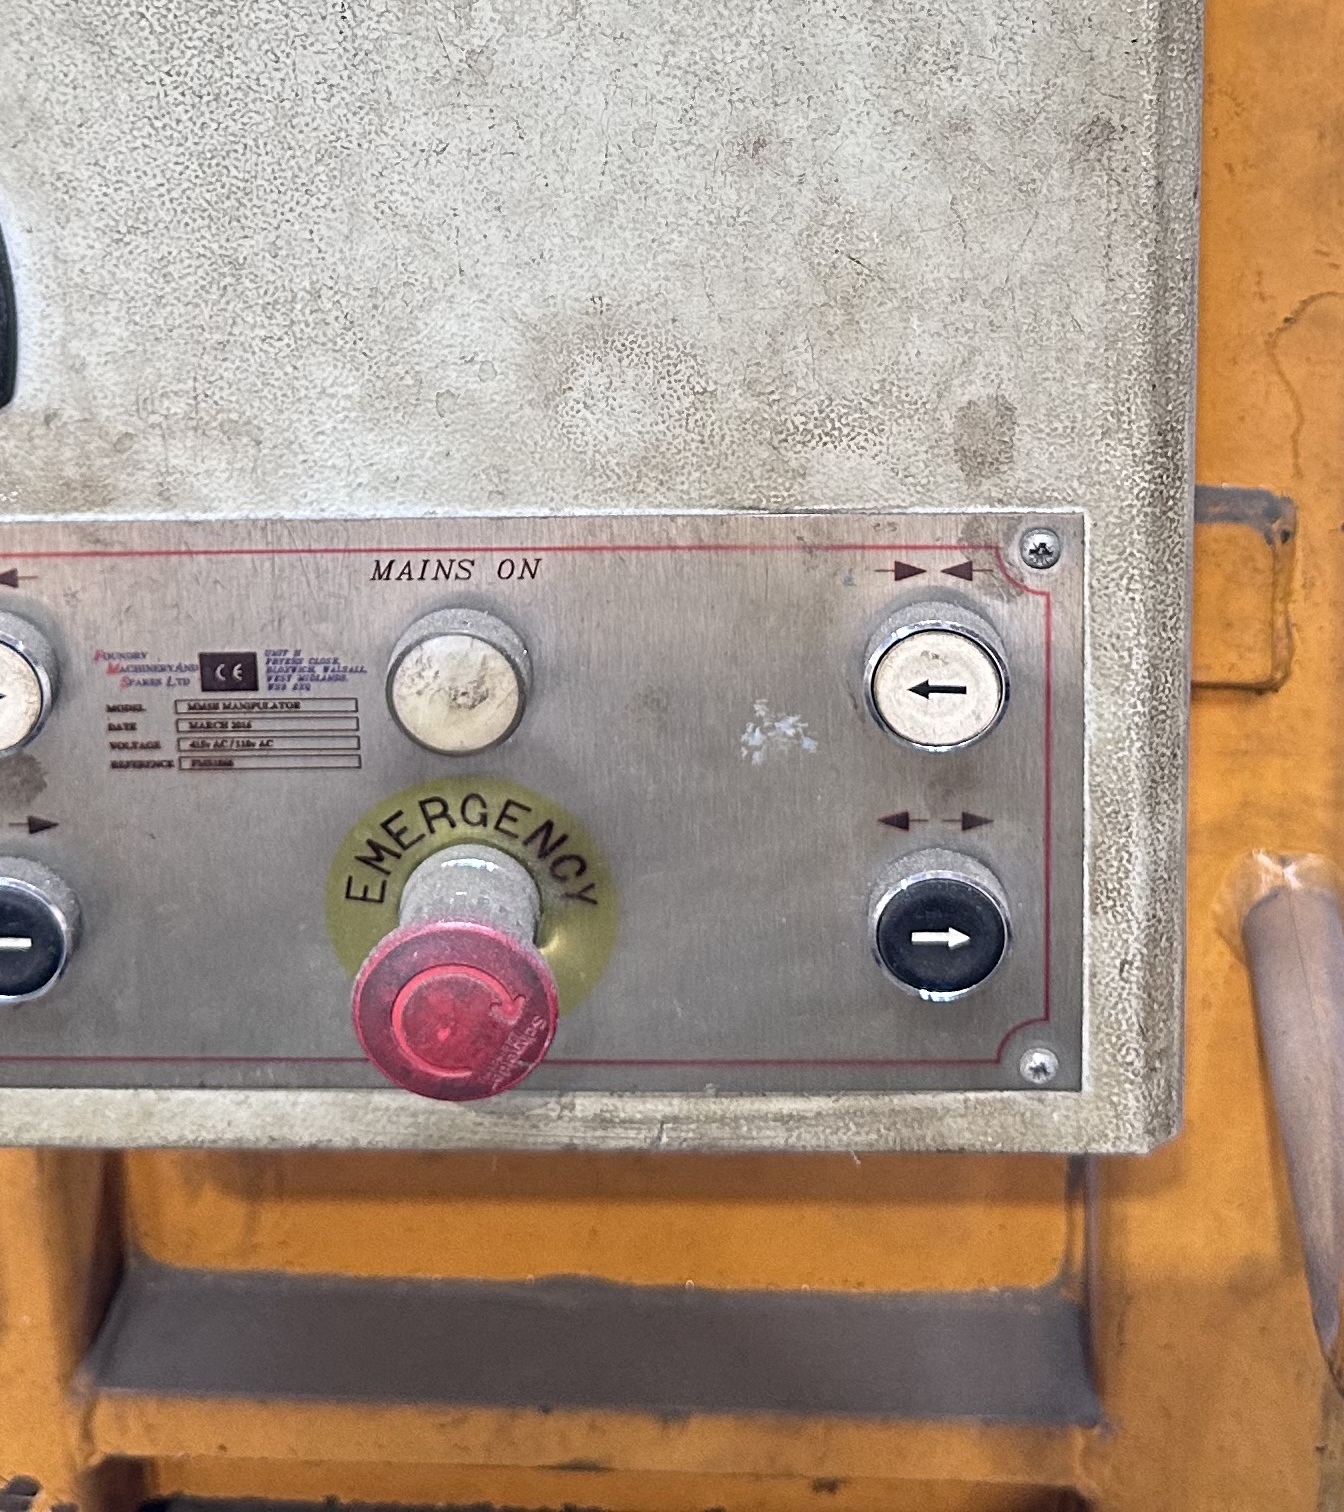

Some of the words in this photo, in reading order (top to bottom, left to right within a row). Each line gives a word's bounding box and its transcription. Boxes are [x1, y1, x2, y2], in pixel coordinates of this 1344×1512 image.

[370, 558, 475, 581] MAINS
[497, 558, 542, 580] ON
[223, 701, 301, 710] MANIPULATOR
[108, 722, 137, 731] DATE
[189, 721, 228, 730] MARCH
[109, 741, 161, 750] VOLTAGE
[111, 759, 174, 769] REFERENCE
[345, 793, 598, 906] EMERGENCY
